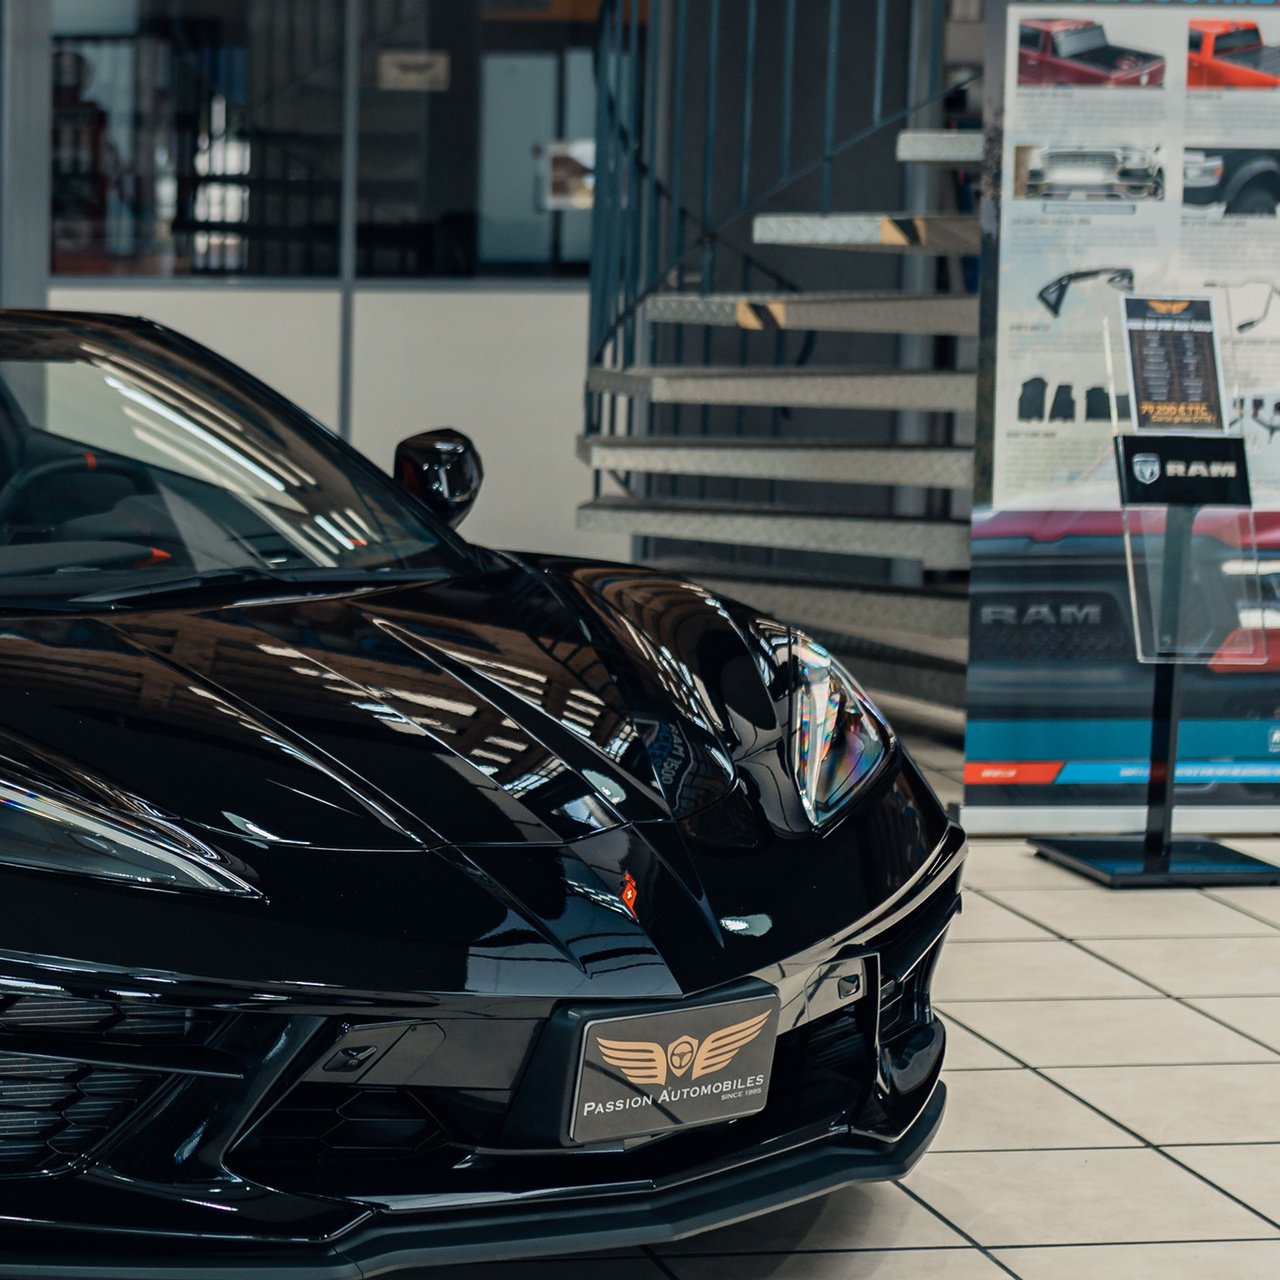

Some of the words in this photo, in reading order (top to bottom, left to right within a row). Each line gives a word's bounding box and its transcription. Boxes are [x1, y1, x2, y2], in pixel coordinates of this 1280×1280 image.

[1166, 461, 1236, 478] RAM
[980, 604, 1101, 624] RAM
[721, 1091, 743, 1101] SINCE
[745, 1088, 762, 1097] 1995
